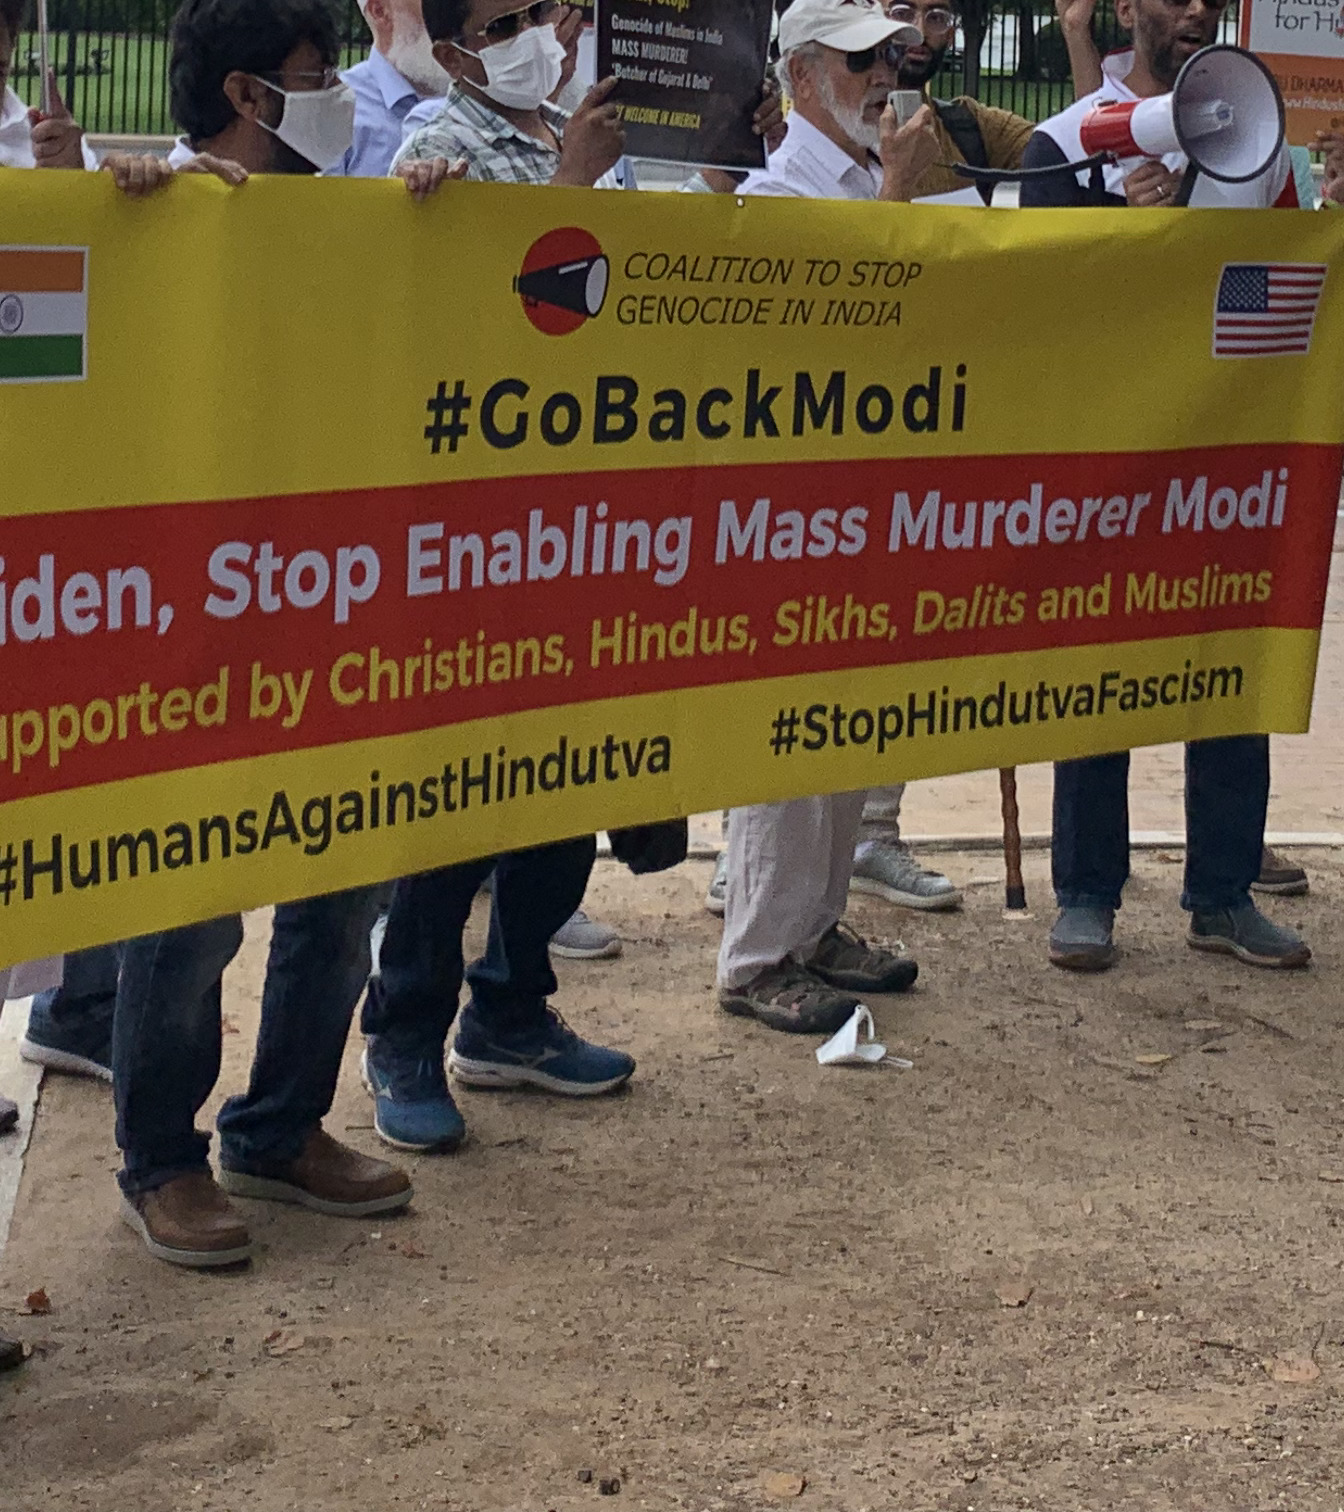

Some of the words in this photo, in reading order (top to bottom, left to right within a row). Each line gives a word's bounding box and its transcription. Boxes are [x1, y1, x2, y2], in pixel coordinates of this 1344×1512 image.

[611, 13, 653, 35] Genocide
[654, 21, 664, 36] of
[665, 21, 695, 41] Muslims
[697, 27, 704, 41] in
[704, 27, 723, 46] India
[1275, 3, 1311, 29] for
[611, 39, 639, 58] MASS
[641, 42, 689, 65] MURDERER!
[649, 69, 658, 82] of
[658, 69, 685, 88] Gujarat
[685, 72, 691, 88] &
[1292, 75, 1344, 94] DHARMA
[623, 105, 660, 125] WELCOME
[661, 109, 669, 125] IN
[669, 109, 701, 130] AMERICA
[623, 252, 793, 286] COALITION
[804, 258, 841, 286] TO
[848, 260, 923, 290] STOP
[617, 294, 771, 326] GENOCIDE
[780, 297, 818, 326] IN
[822, 298, 902, 328] INDIA
[424, 364, 968, 454] #GoBackModi
[203, 541, 382, 624] Stop
[406, 501, 693, 597] Enabling
[714, 497, 868, 565] Mass
[888, 481, 1148, 553] Murderer
[1161, 468, 1288, 534] Modi
[249, 662, 313, 728] by
[329, 630, 574, 707] Christians,
[590, 609, 758, 669] Hindus,
[772, 591, 899, 649] Sikhs,
[912, 580, 1027, 636] Dalits
[1037, 576, 1112, 621] and
[1124, 563, 1272, 615] Muslims
[769, 659, 1244, 757] #StopHindutvaFascism
